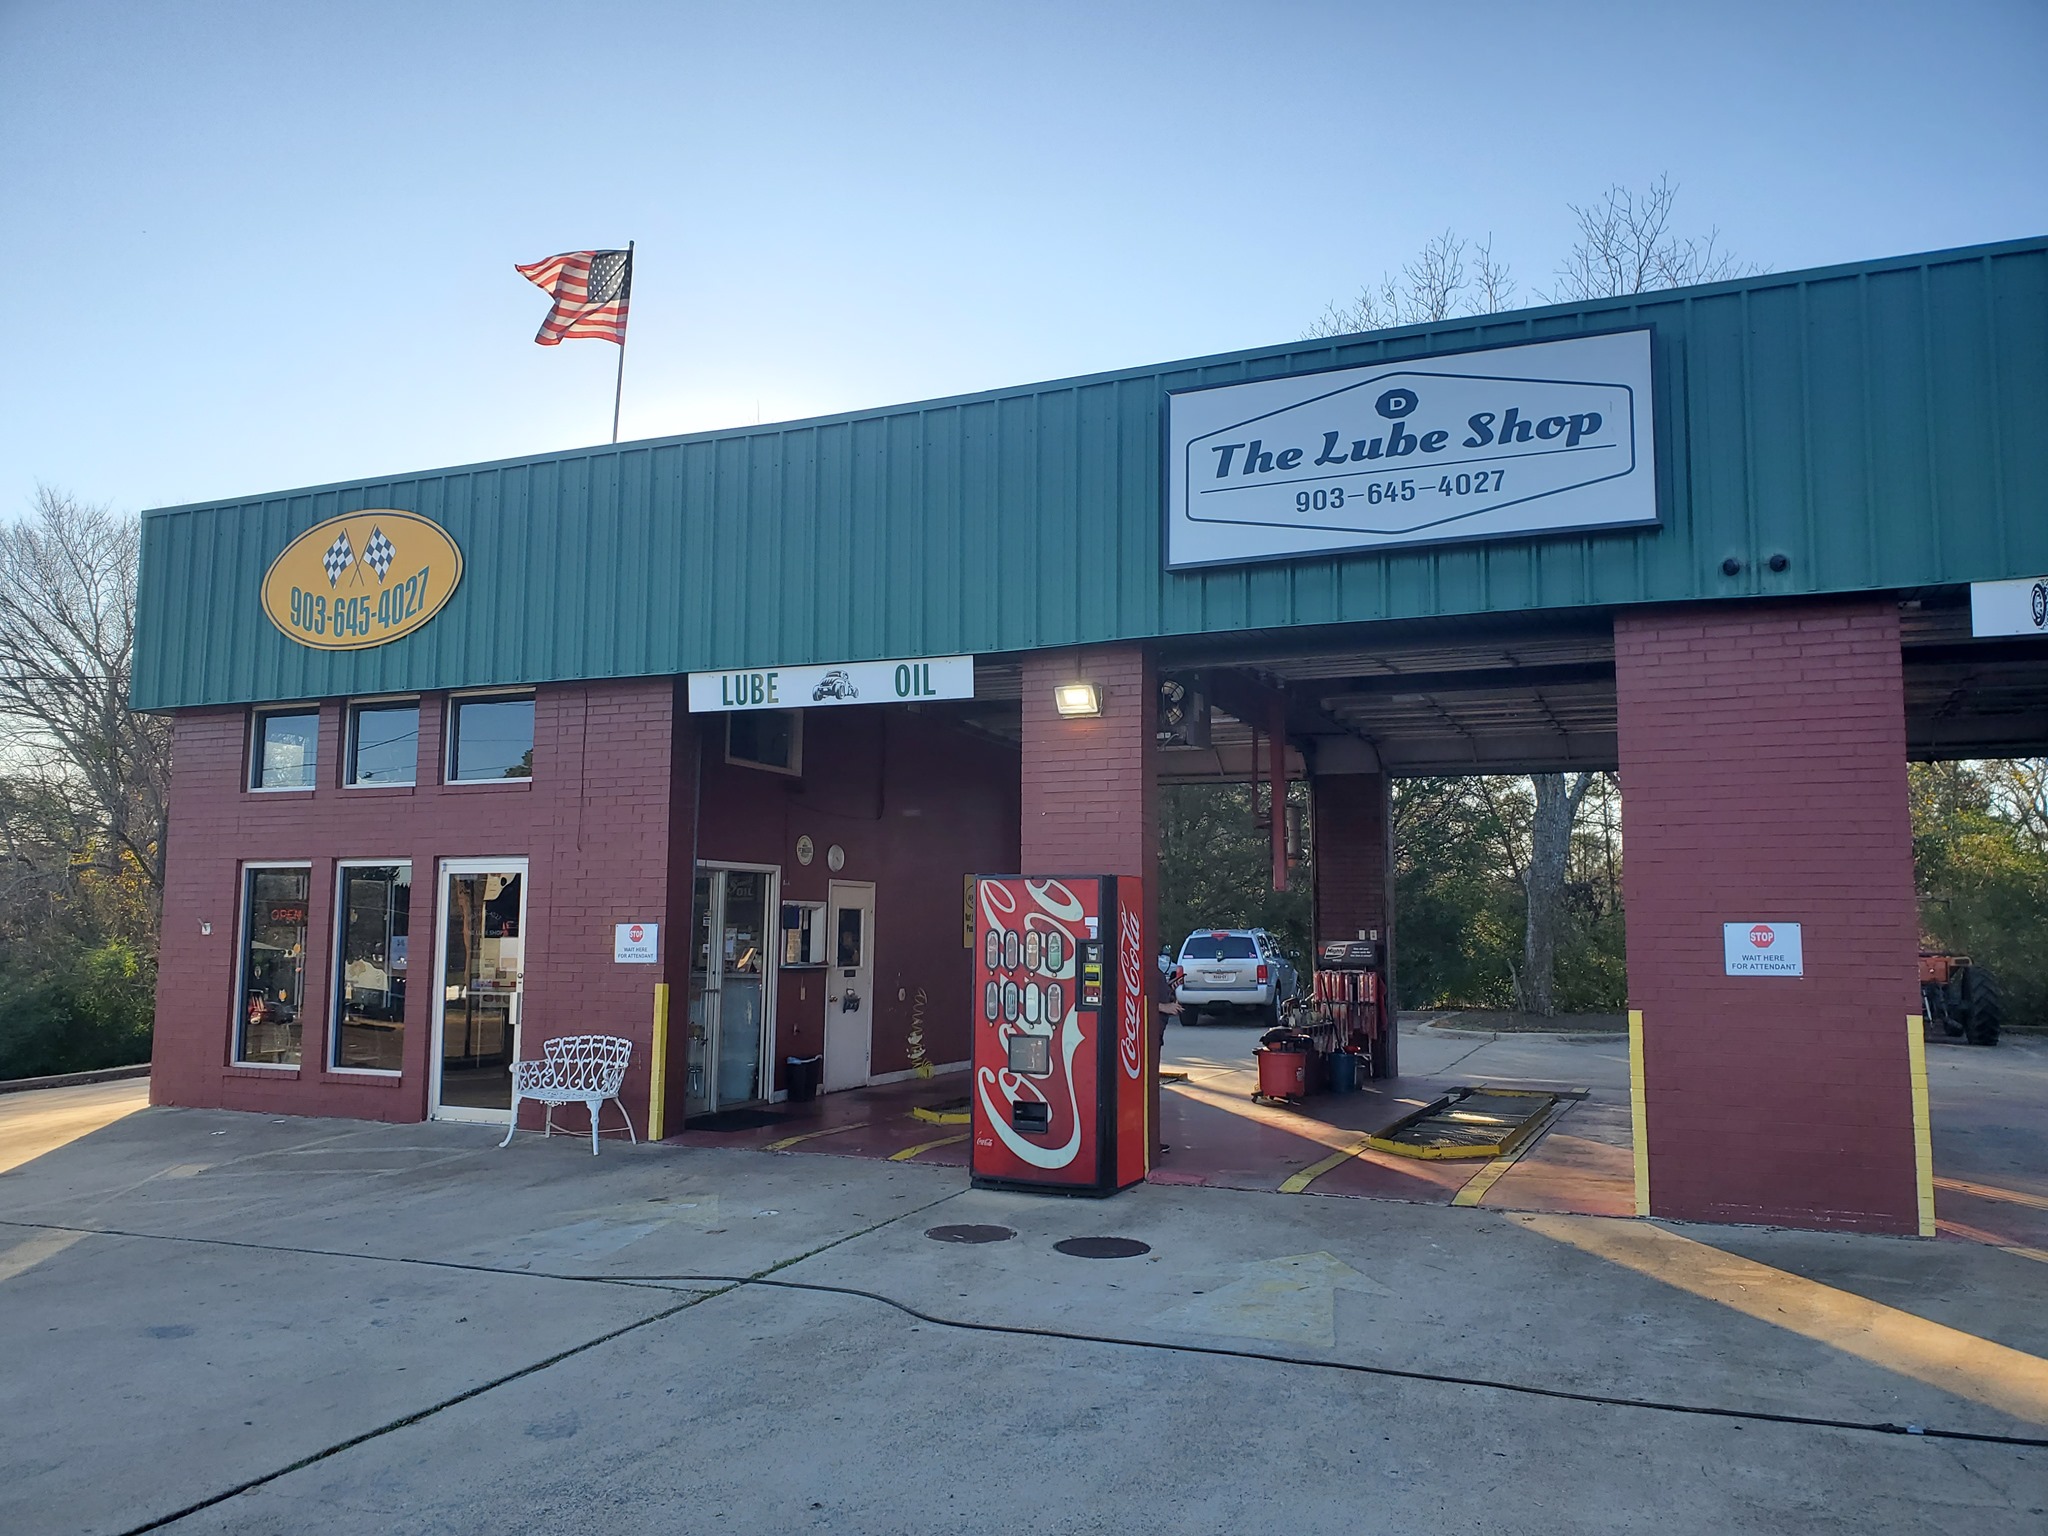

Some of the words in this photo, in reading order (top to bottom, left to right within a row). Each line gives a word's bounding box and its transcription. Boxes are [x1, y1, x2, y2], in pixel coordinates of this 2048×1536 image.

[1389, 397, 1407, 411] D
[1211, 439, 1303, 478] The
[1314, 421, 1449, 466] Lube
[1462, 407, 1603, 447] Shop
[1296, 470, 1505, 512] 903-645-4027
[290, 565, 430, 637] 903-645-4027
[722, 672, 779, 706] LUBE
[895, 663, 936, 698] OIL
[271, 909, 303, 920] OPEN
[1750, 932, 1774, 942] STOP
[1120, 900, 1141, 1079] Coca-Cola
